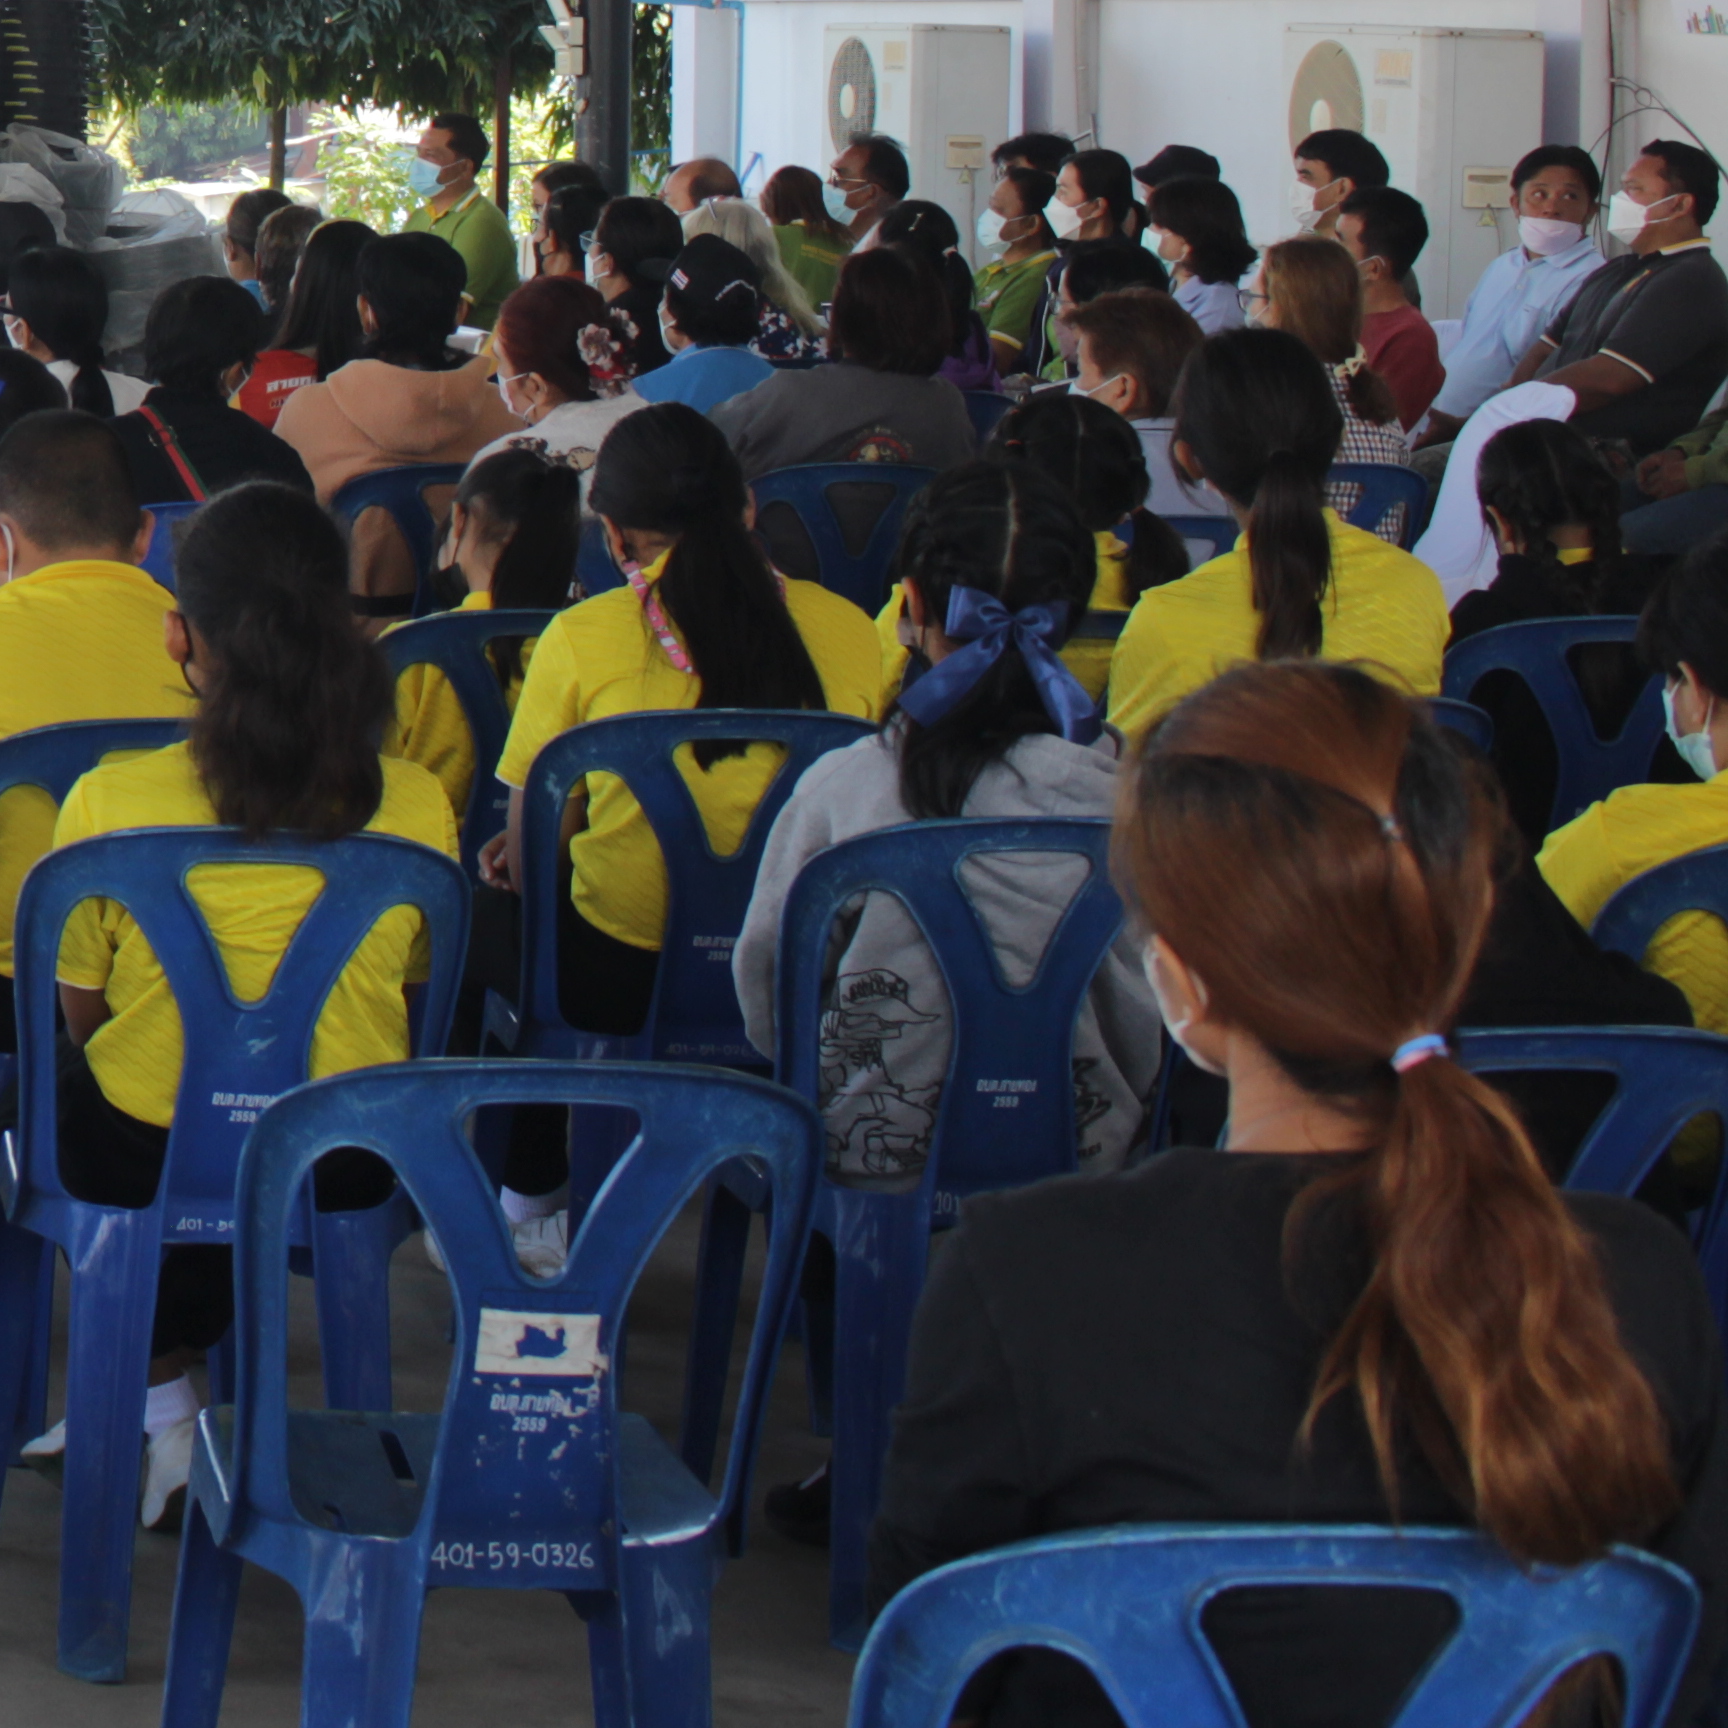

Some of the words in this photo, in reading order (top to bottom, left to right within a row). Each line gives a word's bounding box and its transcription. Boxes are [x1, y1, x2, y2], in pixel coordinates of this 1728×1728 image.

[229, 1110, 256, 1122] 2559
[512, 1416, 548, 1432] 2559
[431, 1541, 595, 1570] 401-59-0326
